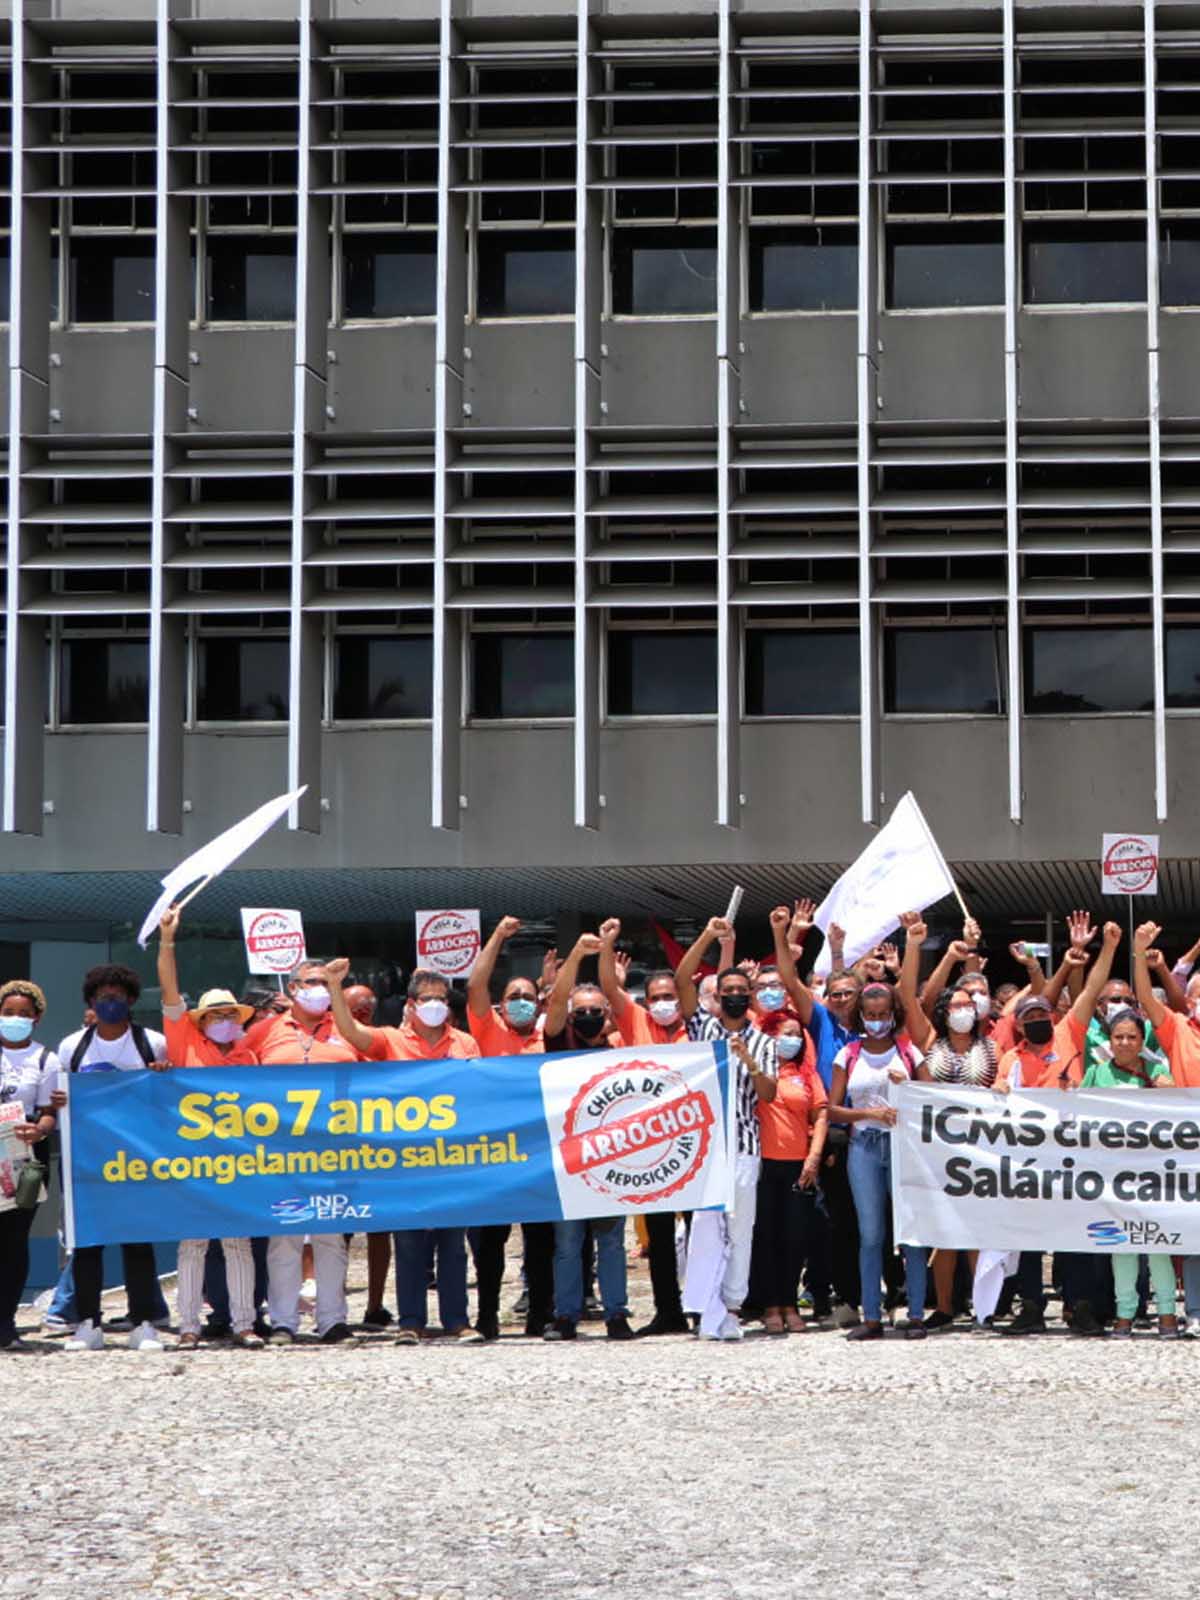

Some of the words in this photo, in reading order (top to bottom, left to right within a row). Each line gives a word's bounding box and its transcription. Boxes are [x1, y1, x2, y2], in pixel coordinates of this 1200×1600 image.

[177, 1091, 279, 1140] São
[286, 1089, 321, 1136] 7
[327, 1094, 457, 1135] anos
[587, 1078, 635, 1116] CHEGA
[641, 1077, 665, 1097] DE
[581, 1100, 705, 1164] ARROCHO!
[921, 1105, 1046, 1147] ICMS
[103, 1151, 147, 1182] de
[152, 1143, 396, 1184] congelamento
[401, 1132, 528, 1168] salarial.
[605, 1159, 680, 1187] REPOSIÇÃO
[678, 1136, 694, 1159] JÁ!
[944, 1155, 1104, 1201] Salário
